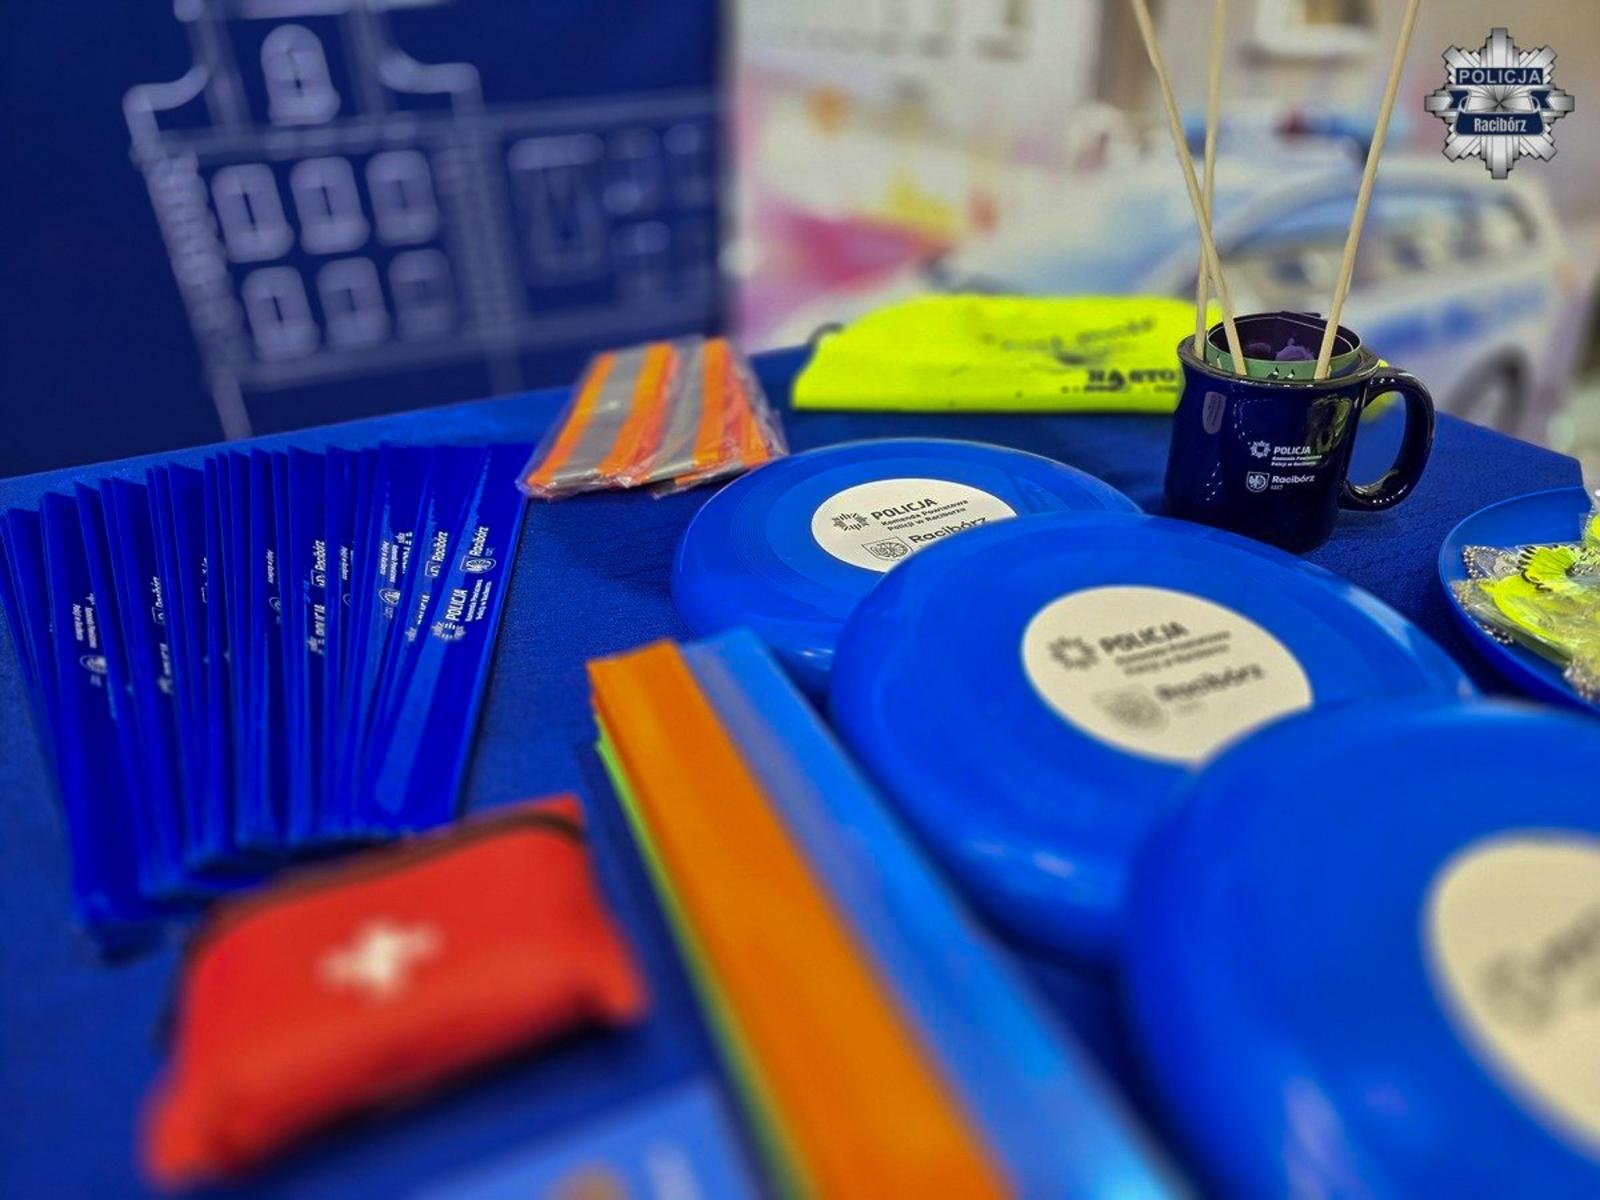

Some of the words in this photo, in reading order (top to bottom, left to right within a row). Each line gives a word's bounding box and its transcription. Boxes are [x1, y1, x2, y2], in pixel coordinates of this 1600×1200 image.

[1273, 446, 1312, 455] POLICJA
[1272, 475, 1315, 483] Racibórz
[870, 498, 938, 521] POLICJA
[880, 513, 920, 527] Komenda
[921, 500, 969, 517] Powiatowa
[887, 521, 915, 533] Policji
[432, 530, 449, 562] Racibórz
[470, 526, 489, 557] Racibórz
[445, 589, 468, 621] POLICJA
